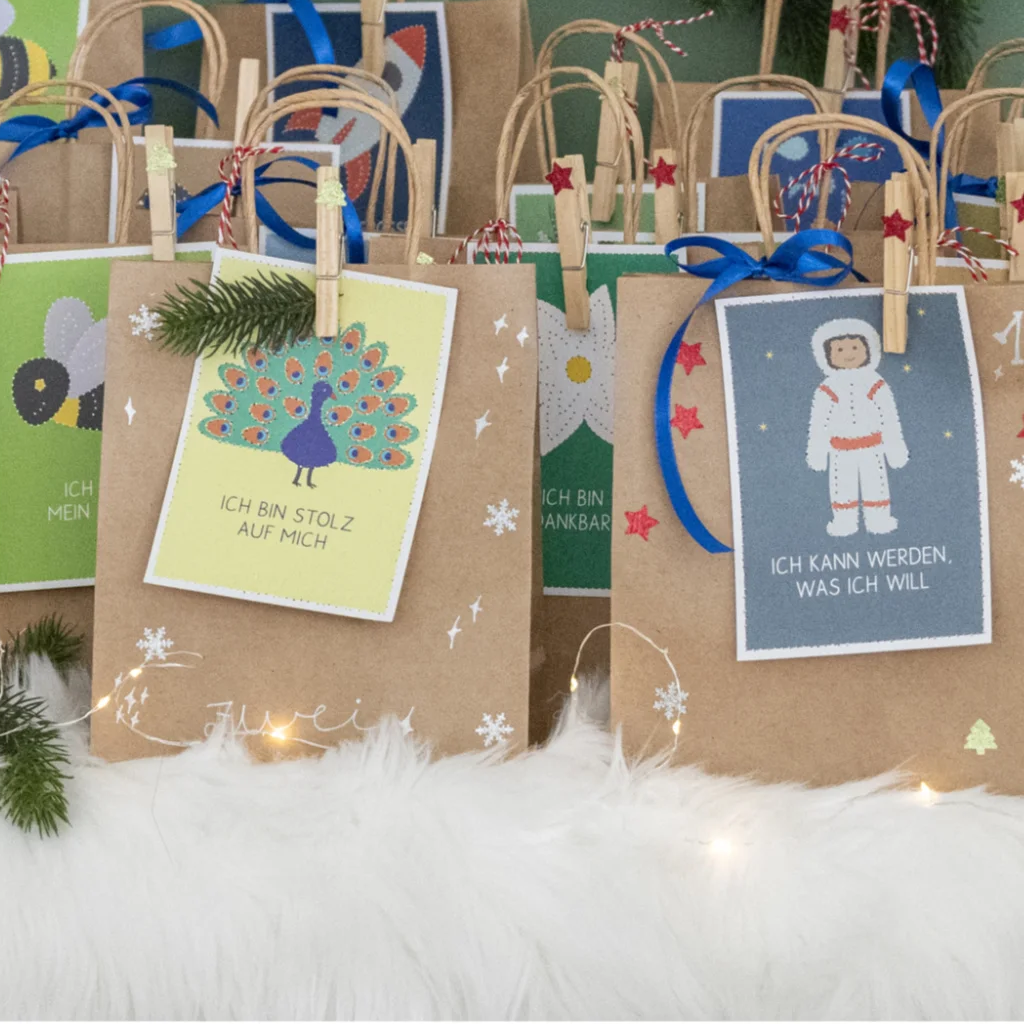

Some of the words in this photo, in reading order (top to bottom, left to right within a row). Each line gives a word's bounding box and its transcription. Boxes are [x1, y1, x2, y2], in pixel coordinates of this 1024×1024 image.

[63, 480, 93, 498] ICH
[542, 488, 570, 506] ICH
[577, 489, 604, 507] BIN
[47, 503, 90, 522] MEIN
[220, 495, 252, 514] ICH
[257, 501, 287, 520] BIN
[292, 508, 355, 532] STOLZ
[541, 513, 611, 531] ANKBAR
[236, 521, 275, 540] AUF
[279, 528, 328, 550] MICH
[770, 556, 802, 575] ICH
[809, 552, 860, 573] KANN
[866, 545, 953, 569] WERDEN,
[795, 578, 841, 599] WAS
[847, 575, 878, 595] ICH
[886, 571, 930, 592] WILL
